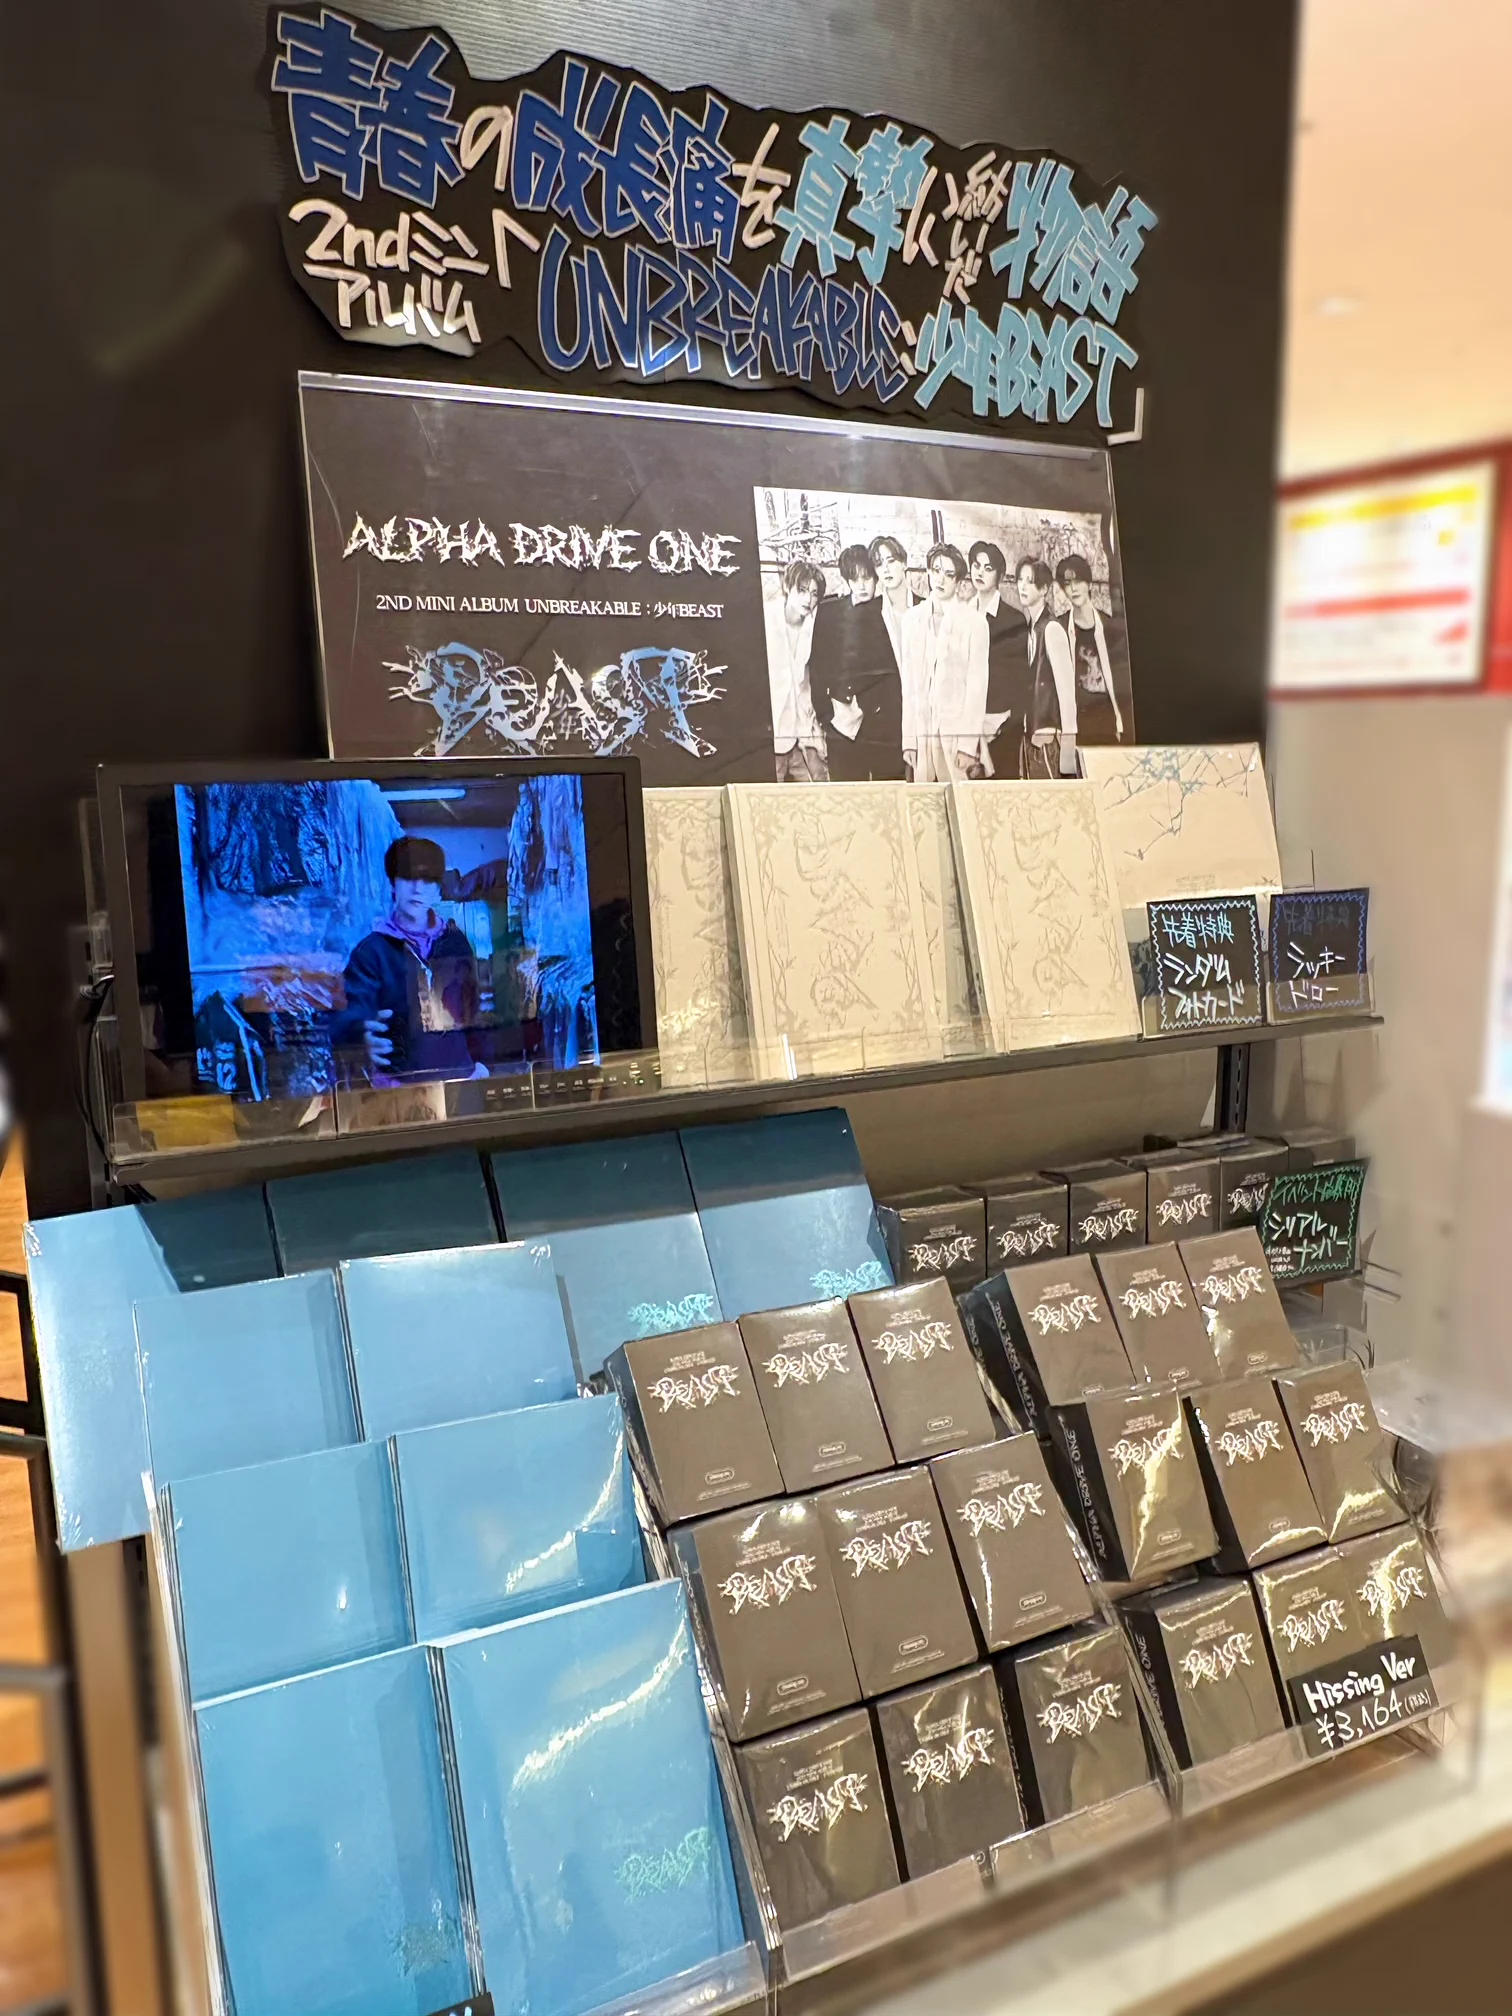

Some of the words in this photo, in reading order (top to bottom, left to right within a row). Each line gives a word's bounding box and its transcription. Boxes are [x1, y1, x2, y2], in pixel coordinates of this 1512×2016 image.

[343, 511, 506, 568] ALPHA
[508, 522, 641, 572] DRIVE
[649, 529, 741, 577] ONE
[376, 595, 412, 611] 2ND
[416, 596, 455, 612] MINI
[459, 597, 519, 614] ALBUM
[524, 599, 641, 616] UNBREAKABLE
[1163, 953, 1232, 987] ランダム
[1287, 941, 1346, 980] ラッキー
[1167, 979, 1245, 1019] フォトカード
[1289, 980, 1339, 1008] ドロー
[1268, 1211, 1328, 1240] シリアル
[1293, 1225, 1348, 1268] ナンバー
[1303, 1671, 1385, 1713] Hissing
[1380, 1652, 1416, 1682] Ver
